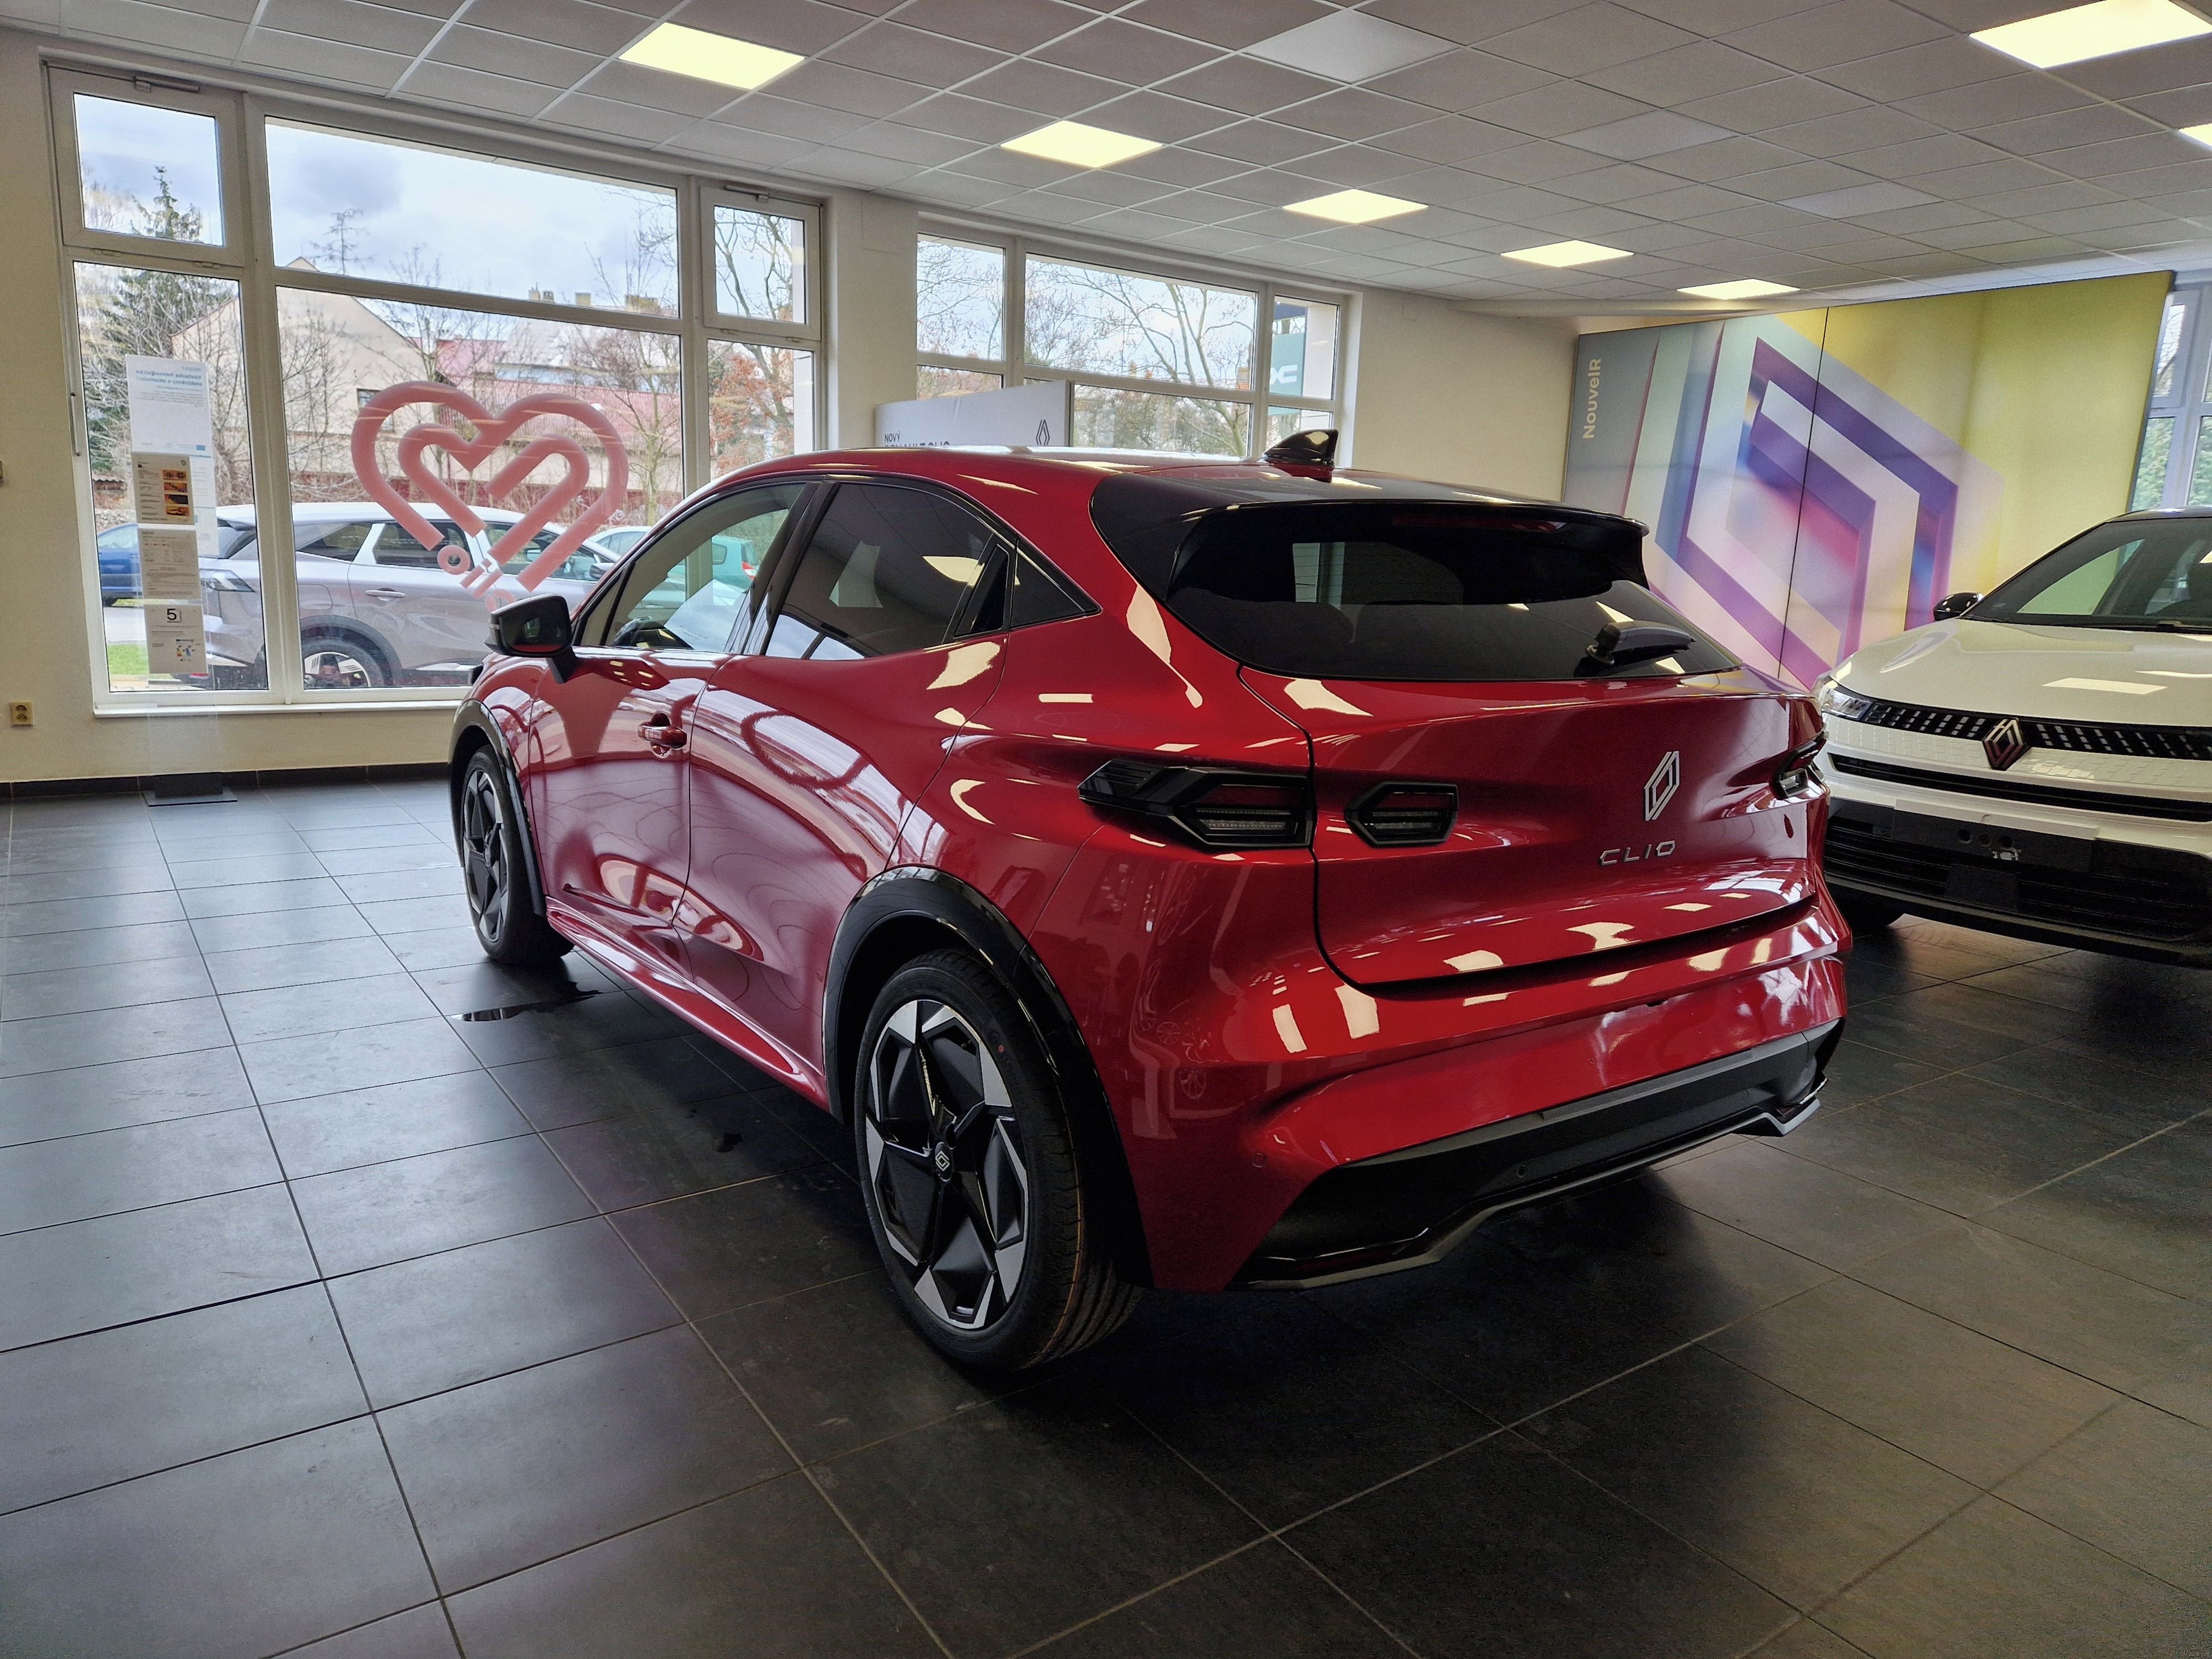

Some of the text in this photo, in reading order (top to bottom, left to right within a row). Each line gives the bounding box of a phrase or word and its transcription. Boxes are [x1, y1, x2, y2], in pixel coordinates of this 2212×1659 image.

[885, 430, 900, 442] NOVÝ
[166, 608, 177, 620] 5
[1599, 840, 1676, 866] CLIO
